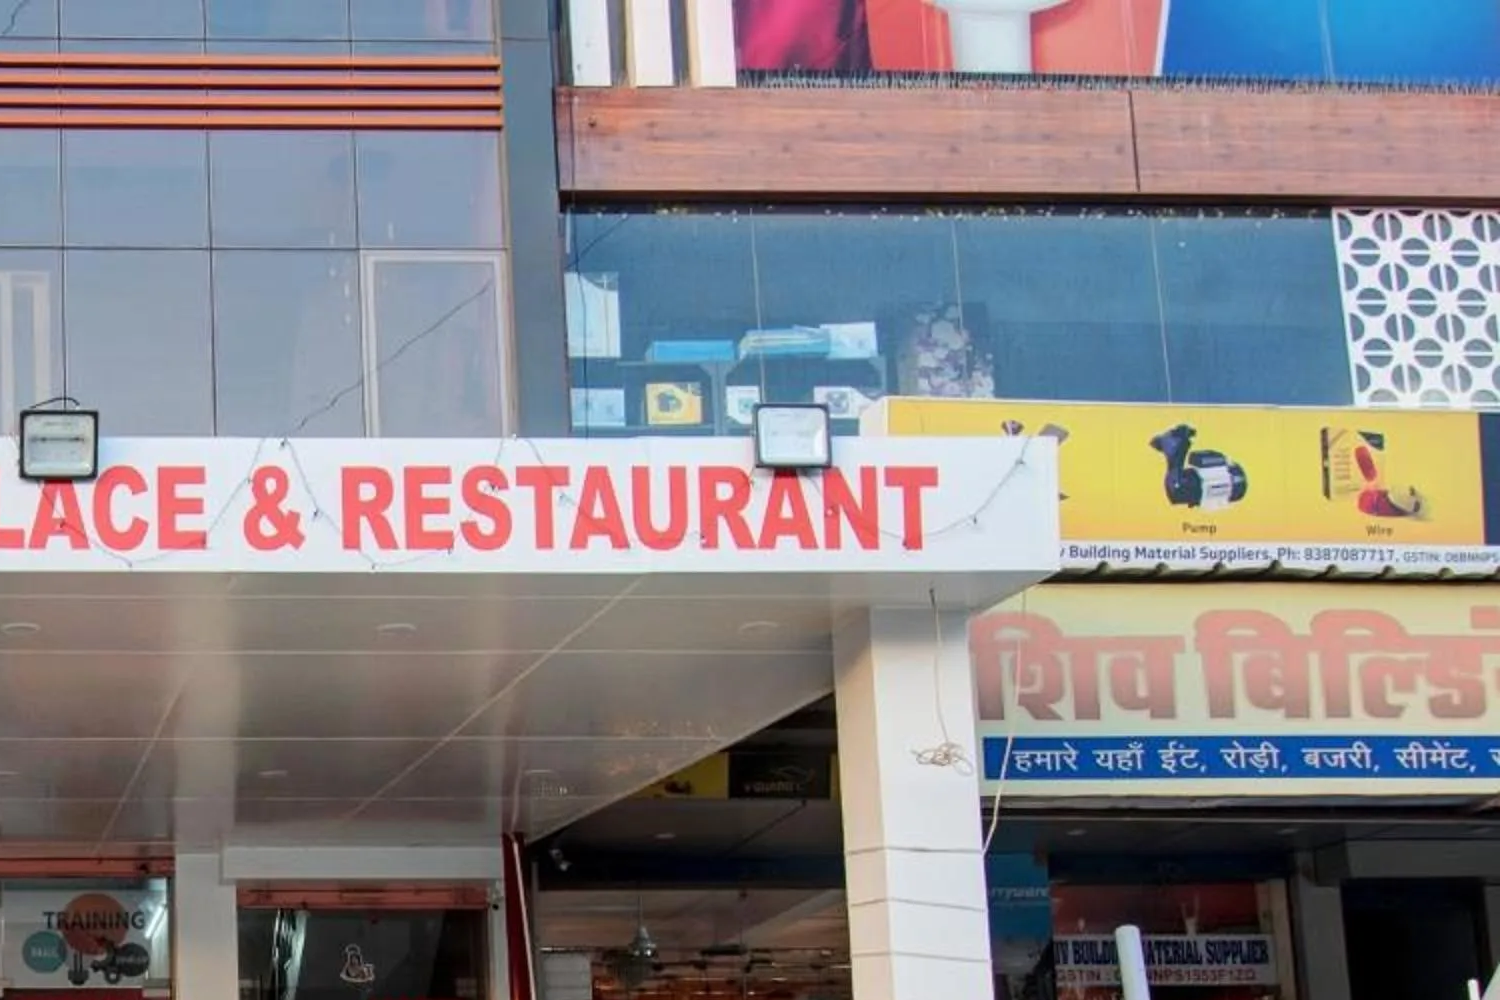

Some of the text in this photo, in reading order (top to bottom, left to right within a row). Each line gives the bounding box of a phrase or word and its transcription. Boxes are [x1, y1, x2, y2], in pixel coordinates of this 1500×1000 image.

[243, 466, 305, 551] &
[341, 466, 938, 551] RESTAURANT
[1183, 522, 1217, 536] Pump
[1366, 525, 1394, 537] Wire
[1069, 545, 1131, 562] Building
[1134, 545, 1196, 560] Material
[1277, 547, 1301, 559] Ph:
[968, 611, 1186, 721] शिव
[1012, 742, 1080, 772] हमारे
[1092, 741, 1145, 771] यहाँ
[1302, 741, 1380, 773] बजरी,
[1393, 740, 1476, 773] सीमेंट,
[43, 910, 145, 931] TRAINING
[1142, 939, 1203, 965] ATERIAL
[1205, 939, 1269, 965] SUPPLIER
